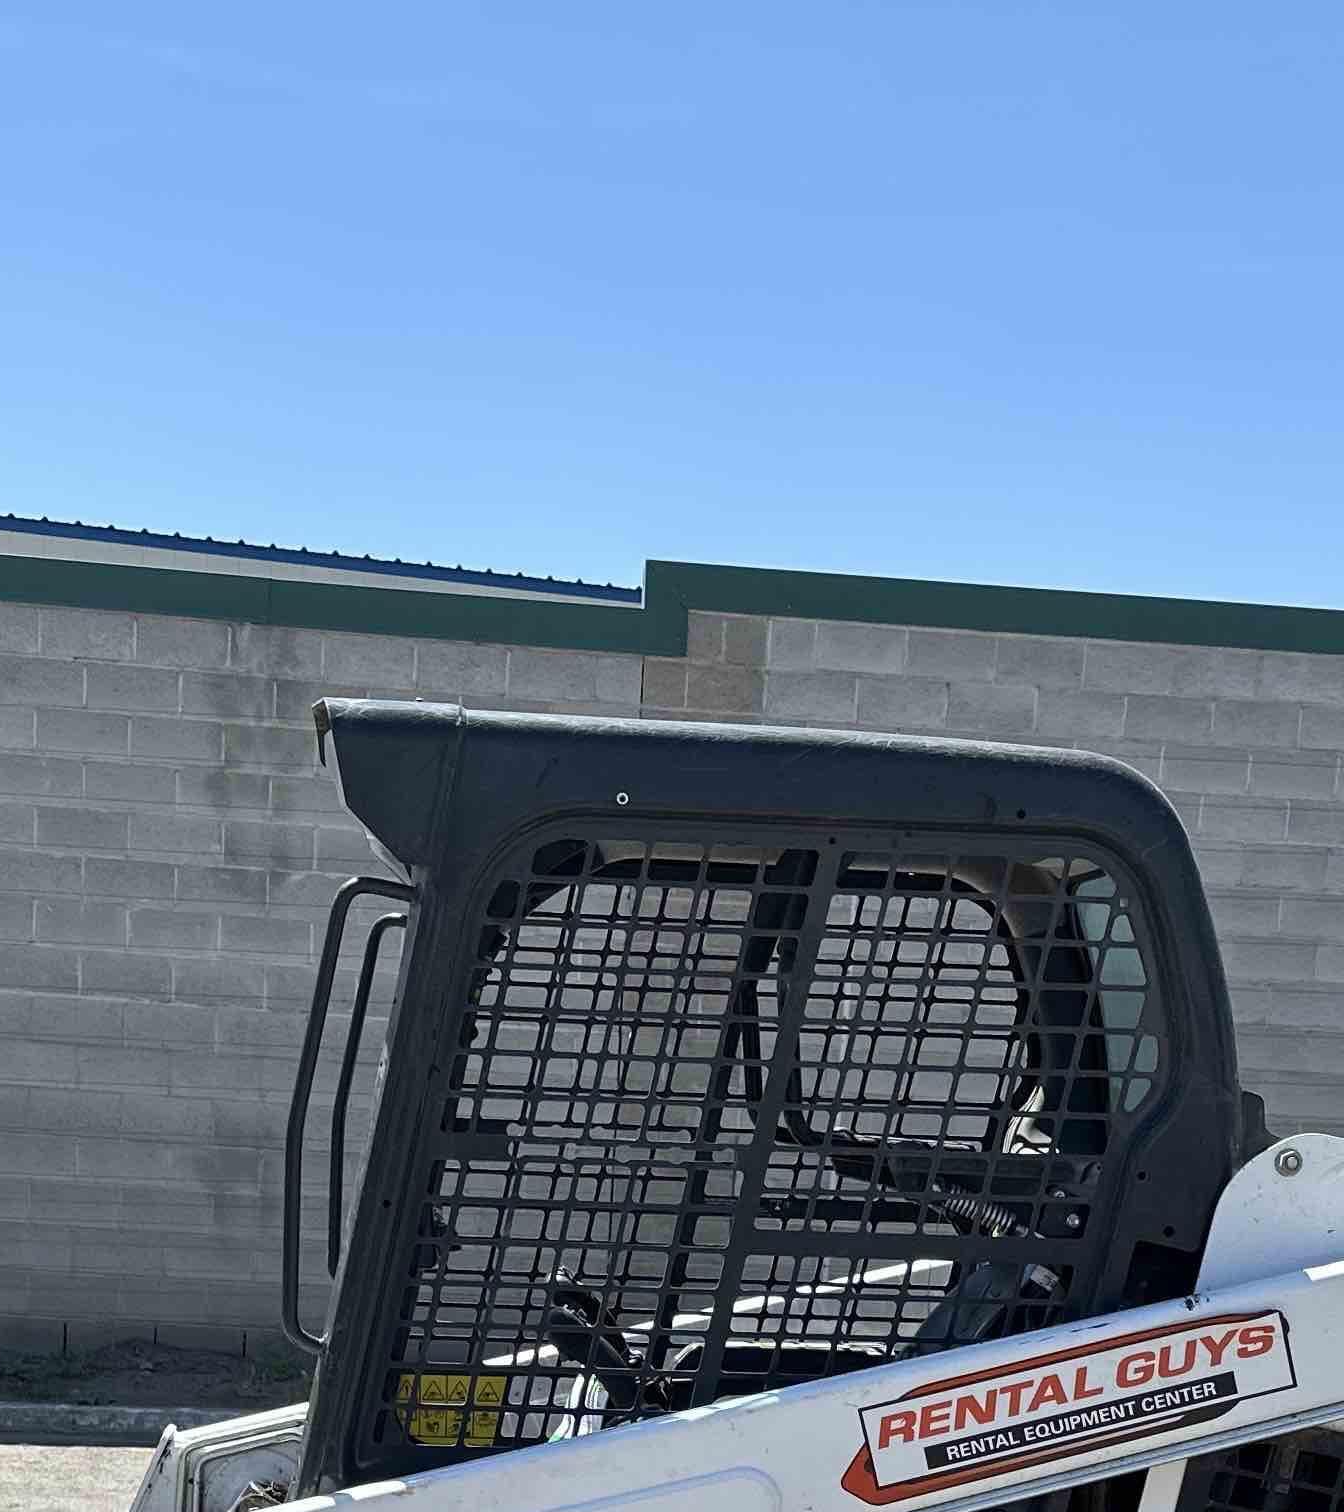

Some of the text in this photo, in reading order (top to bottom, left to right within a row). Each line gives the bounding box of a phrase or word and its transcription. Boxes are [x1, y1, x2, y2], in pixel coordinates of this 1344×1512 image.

[878, 1323, 1276, 1449] RENTAL GUYS
[945, 1381, 1218, 1461] RENTAL EQUIPMENT CENTER
